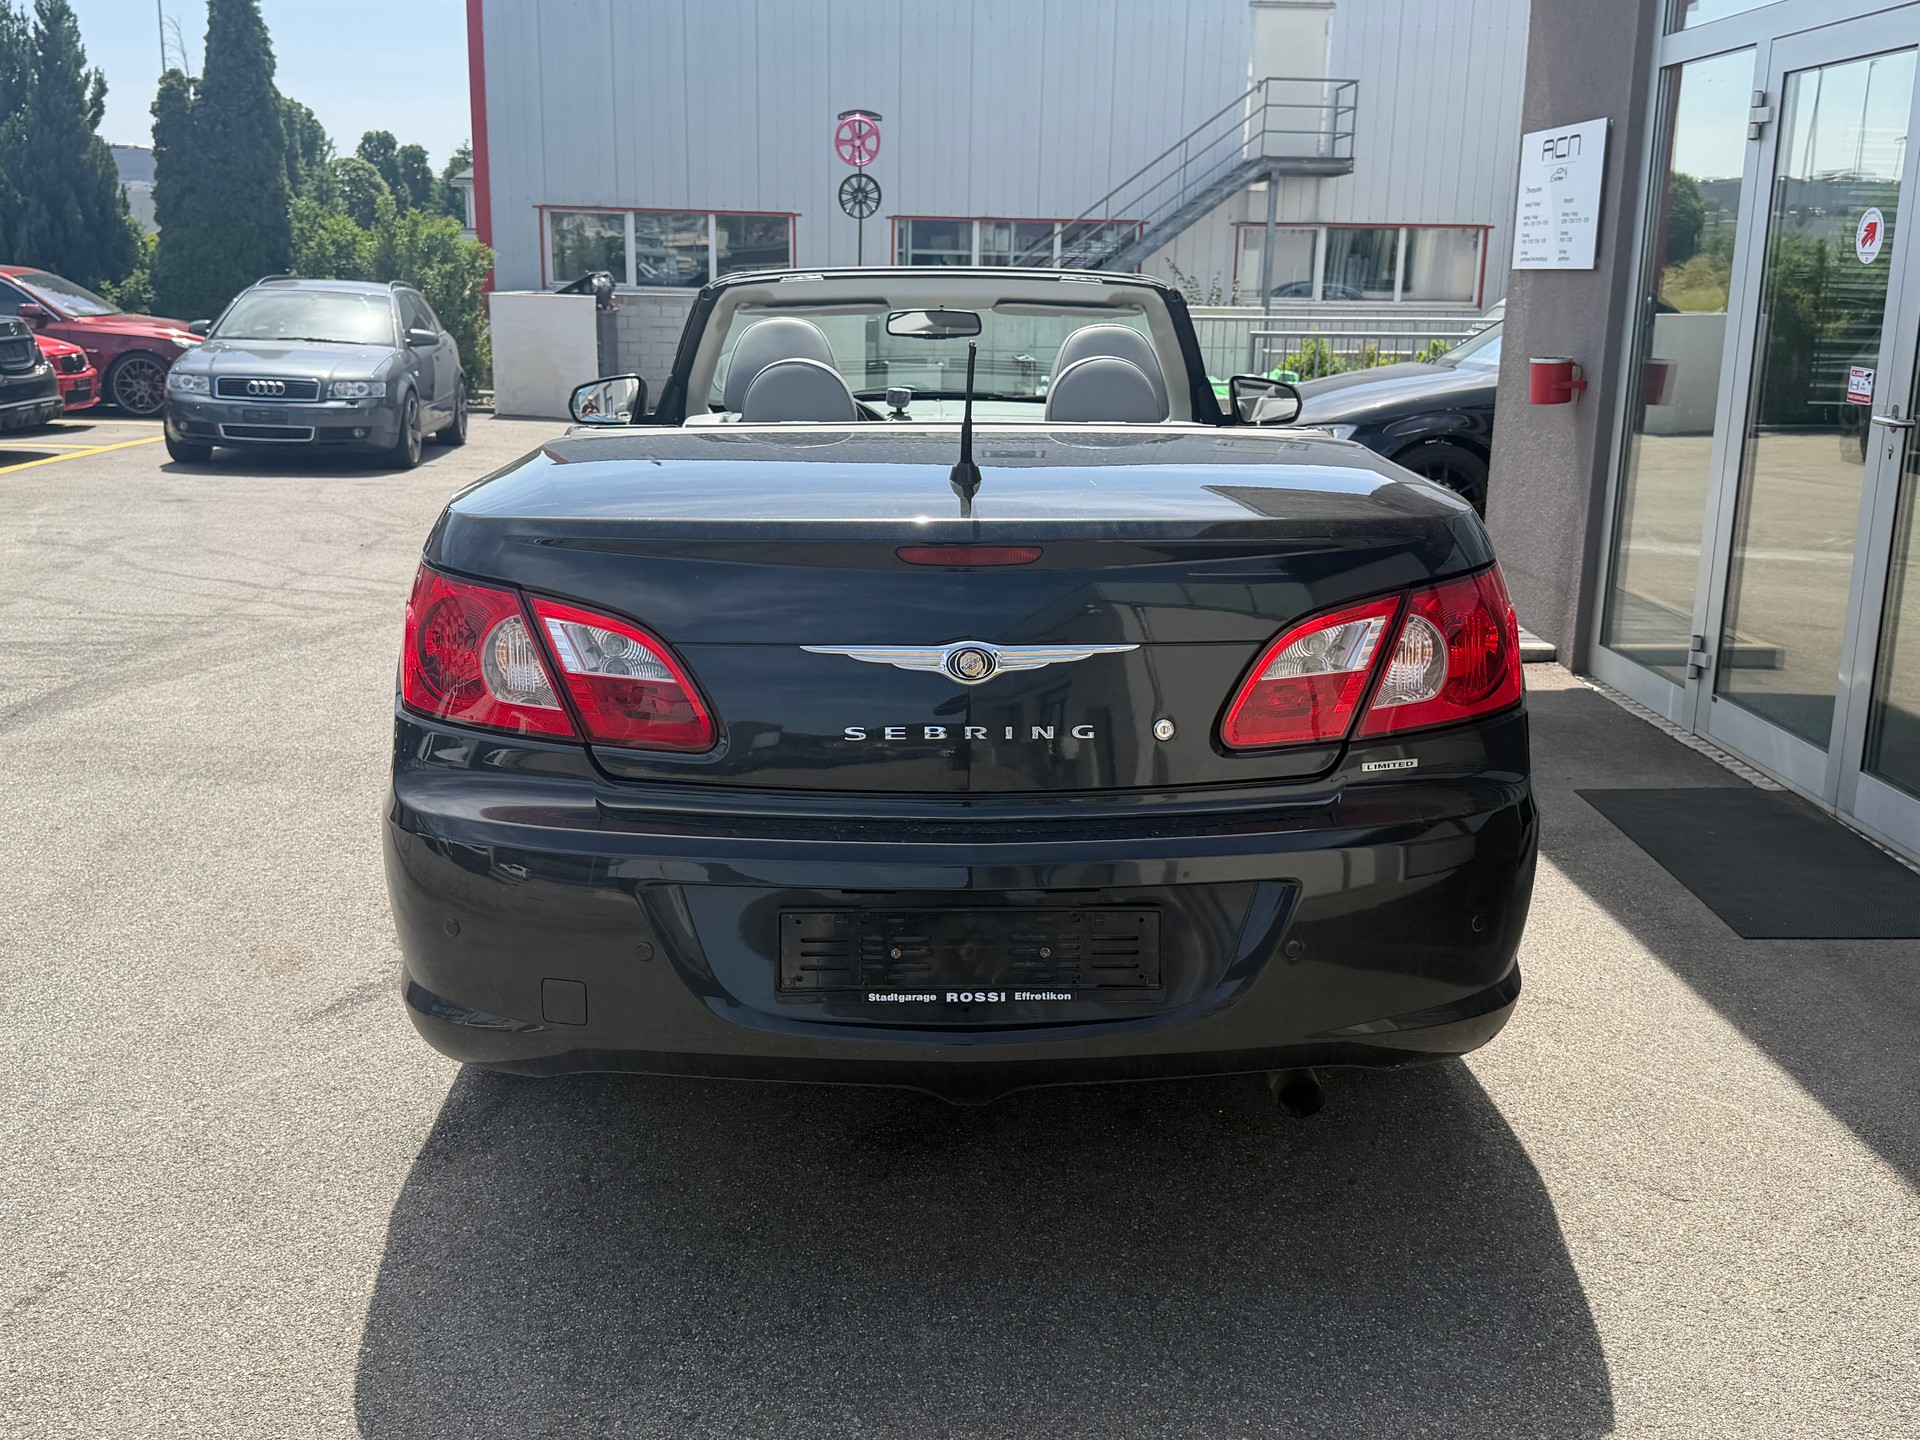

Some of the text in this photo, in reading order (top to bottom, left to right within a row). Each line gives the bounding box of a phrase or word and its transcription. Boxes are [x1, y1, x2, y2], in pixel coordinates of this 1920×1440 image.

[844, 725, 1095, 741] SEBRING
[1367, 761, 1413, 770] LIMITED
[868, 991, 1072, 1003] Stadtgarage ROSSI Effretikon
